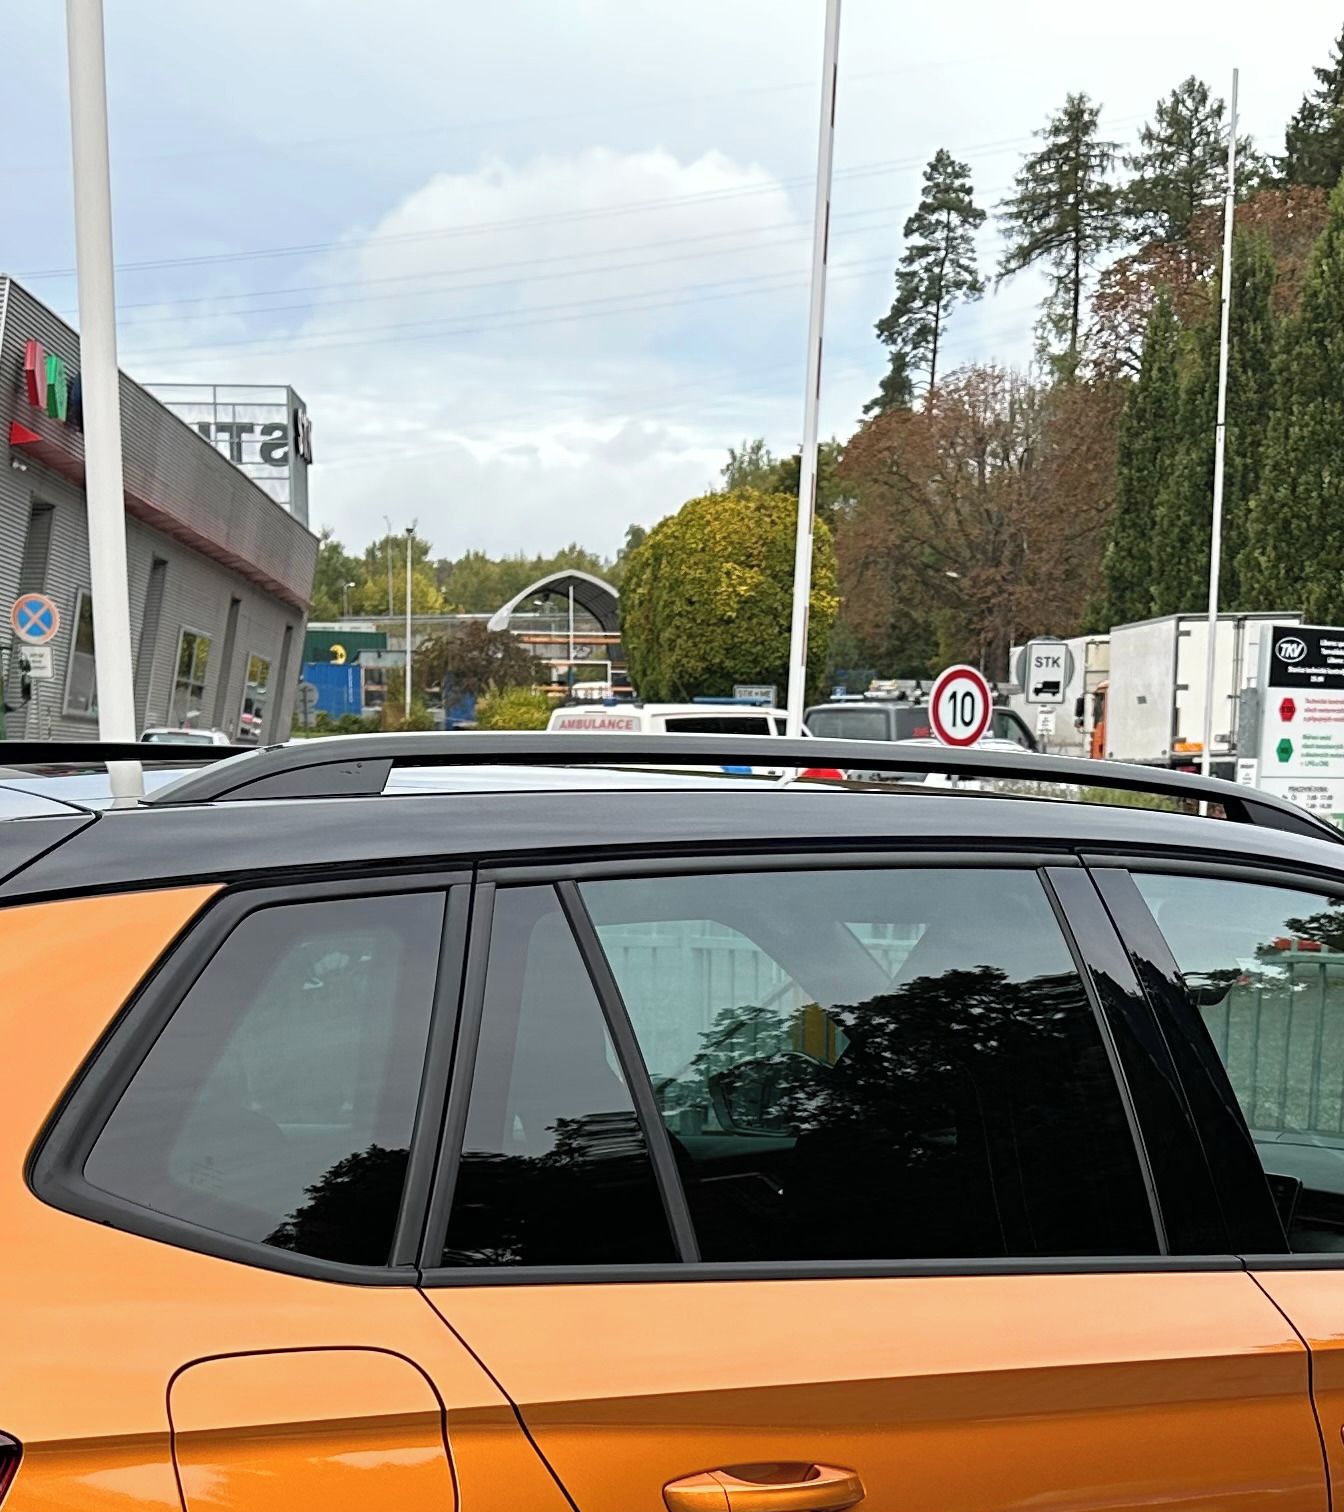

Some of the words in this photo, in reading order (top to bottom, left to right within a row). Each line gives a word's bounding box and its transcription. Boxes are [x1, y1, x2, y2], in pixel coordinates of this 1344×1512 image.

[1280, 643, 1304, 658] TKV
[1034, 656, 1061, 669] STK
[948, 691, 975, 727] 10
[559, 718, 633, 730] AMBULANCE
